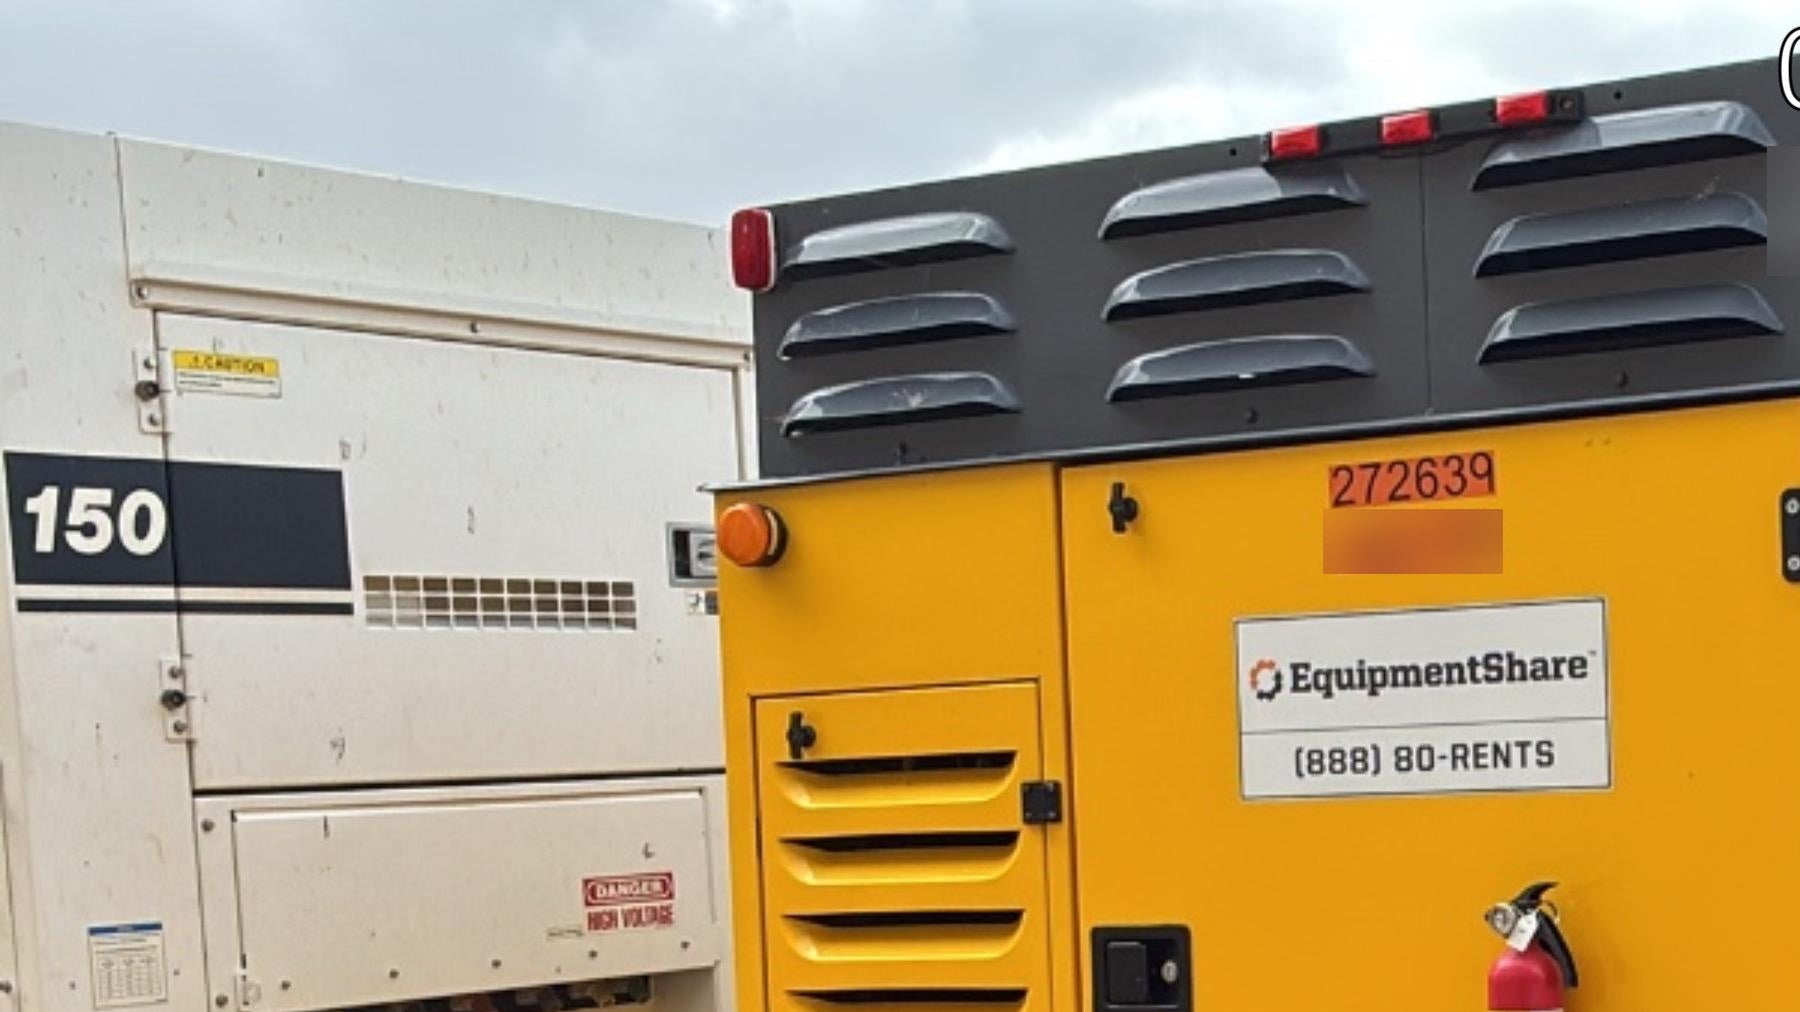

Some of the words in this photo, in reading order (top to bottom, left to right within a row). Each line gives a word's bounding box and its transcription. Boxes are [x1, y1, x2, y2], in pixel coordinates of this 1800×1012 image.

[1331, 450, 1496, 507] 272639
[25, 486, 167, 555] 150
[1294, 744, 1381, 778] (888)
[1394, 739, 1556, 773] 80-RENTS
